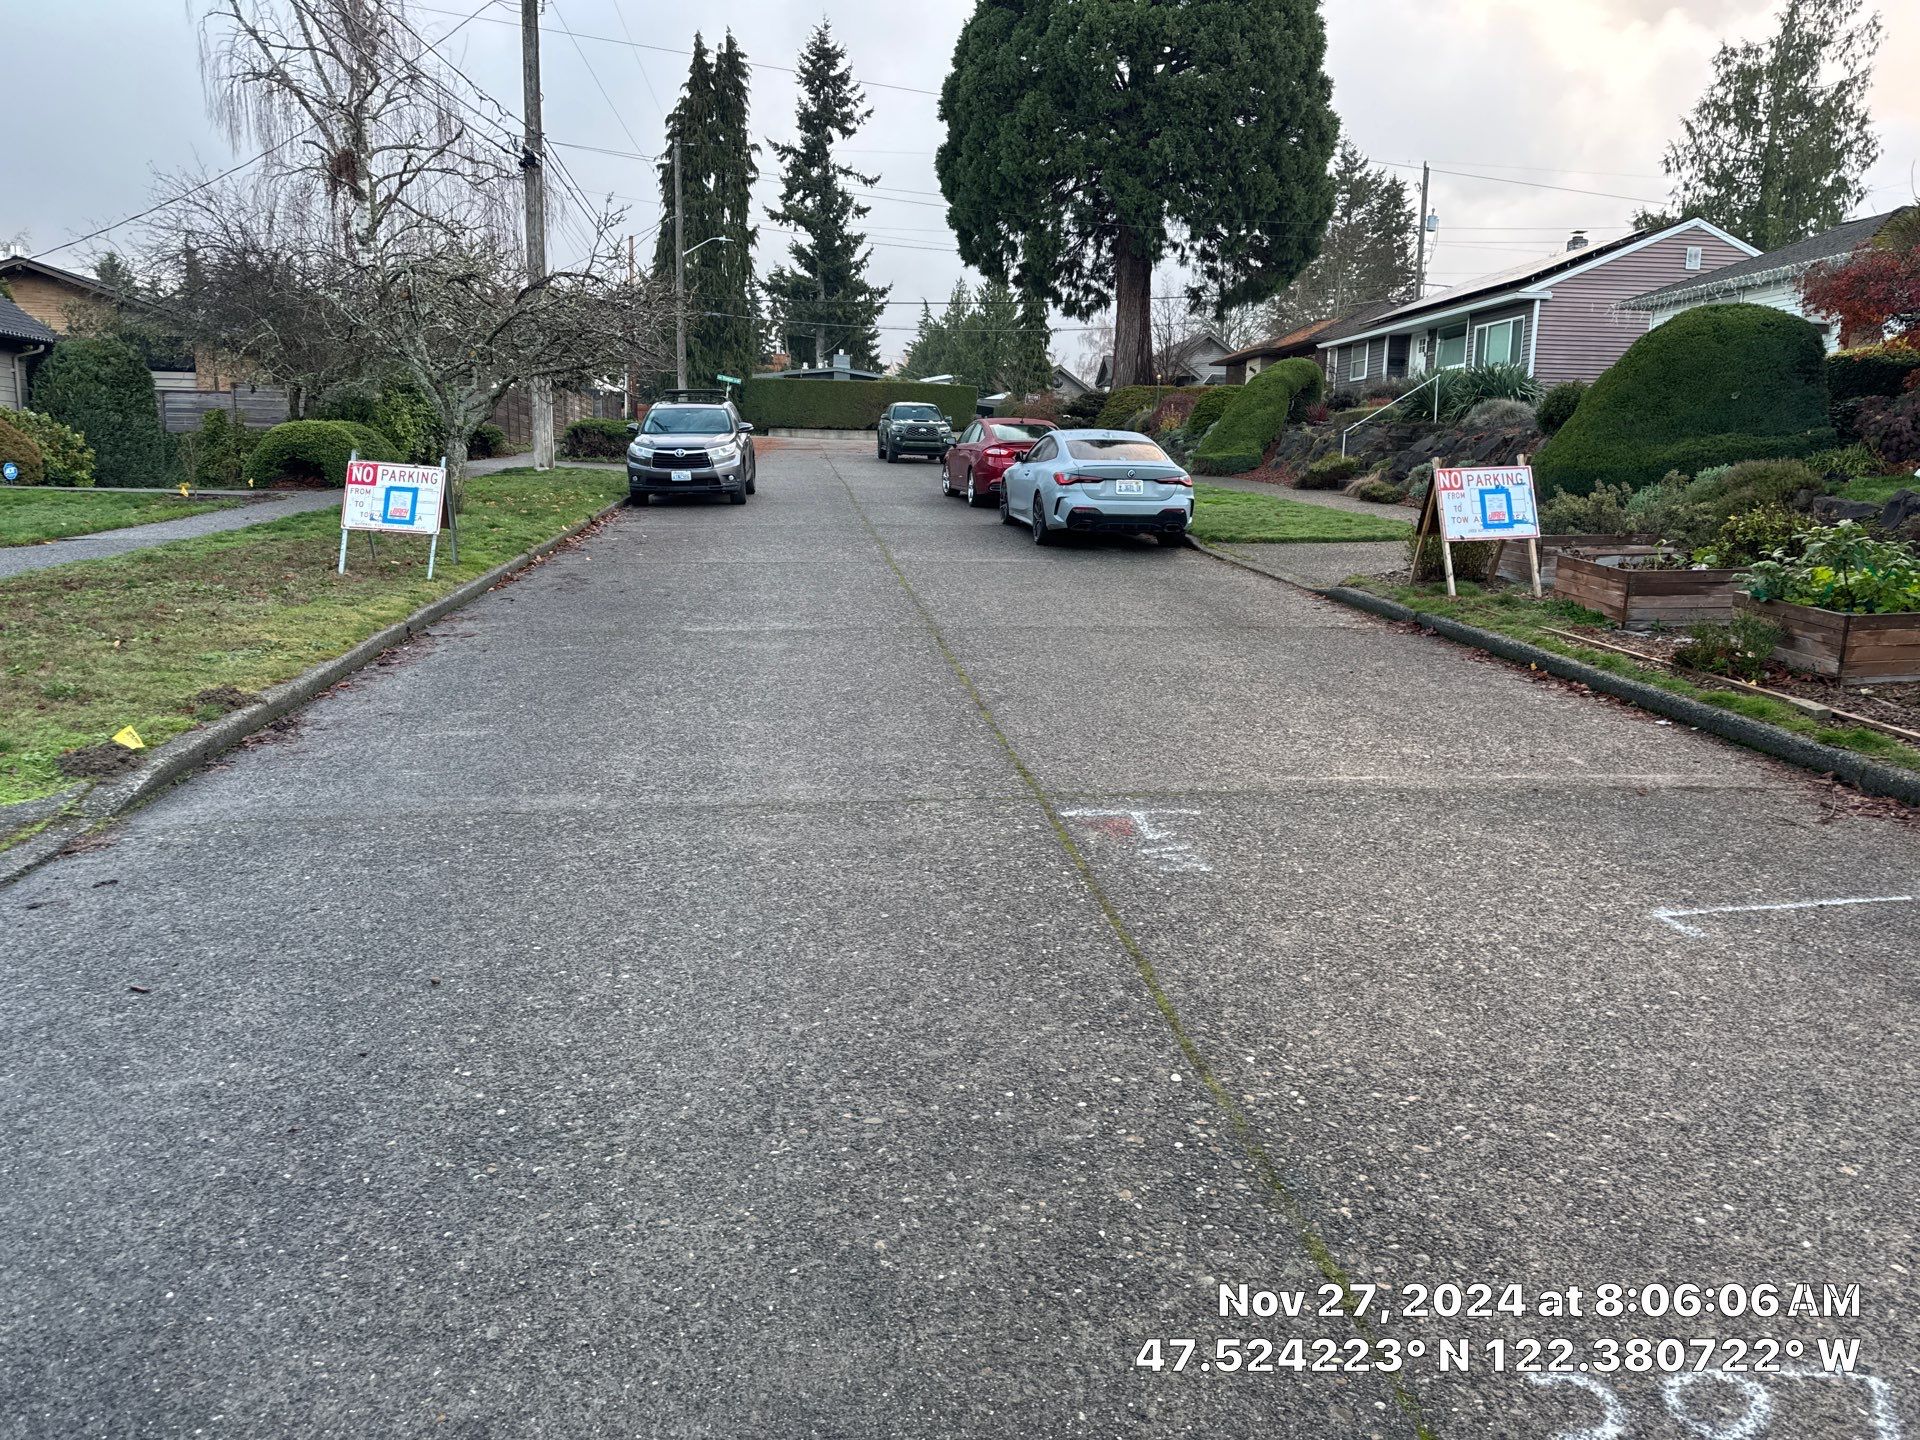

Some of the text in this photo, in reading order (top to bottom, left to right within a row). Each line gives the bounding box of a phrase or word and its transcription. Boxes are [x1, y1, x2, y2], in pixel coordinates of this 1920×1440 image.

[351, 467, 438, 484] NO PARKING
[1440, 472, 1524, 488] NO PARKING
[355, 500, 364, 508] TO
[1453, 504, 1463, 512] TO
